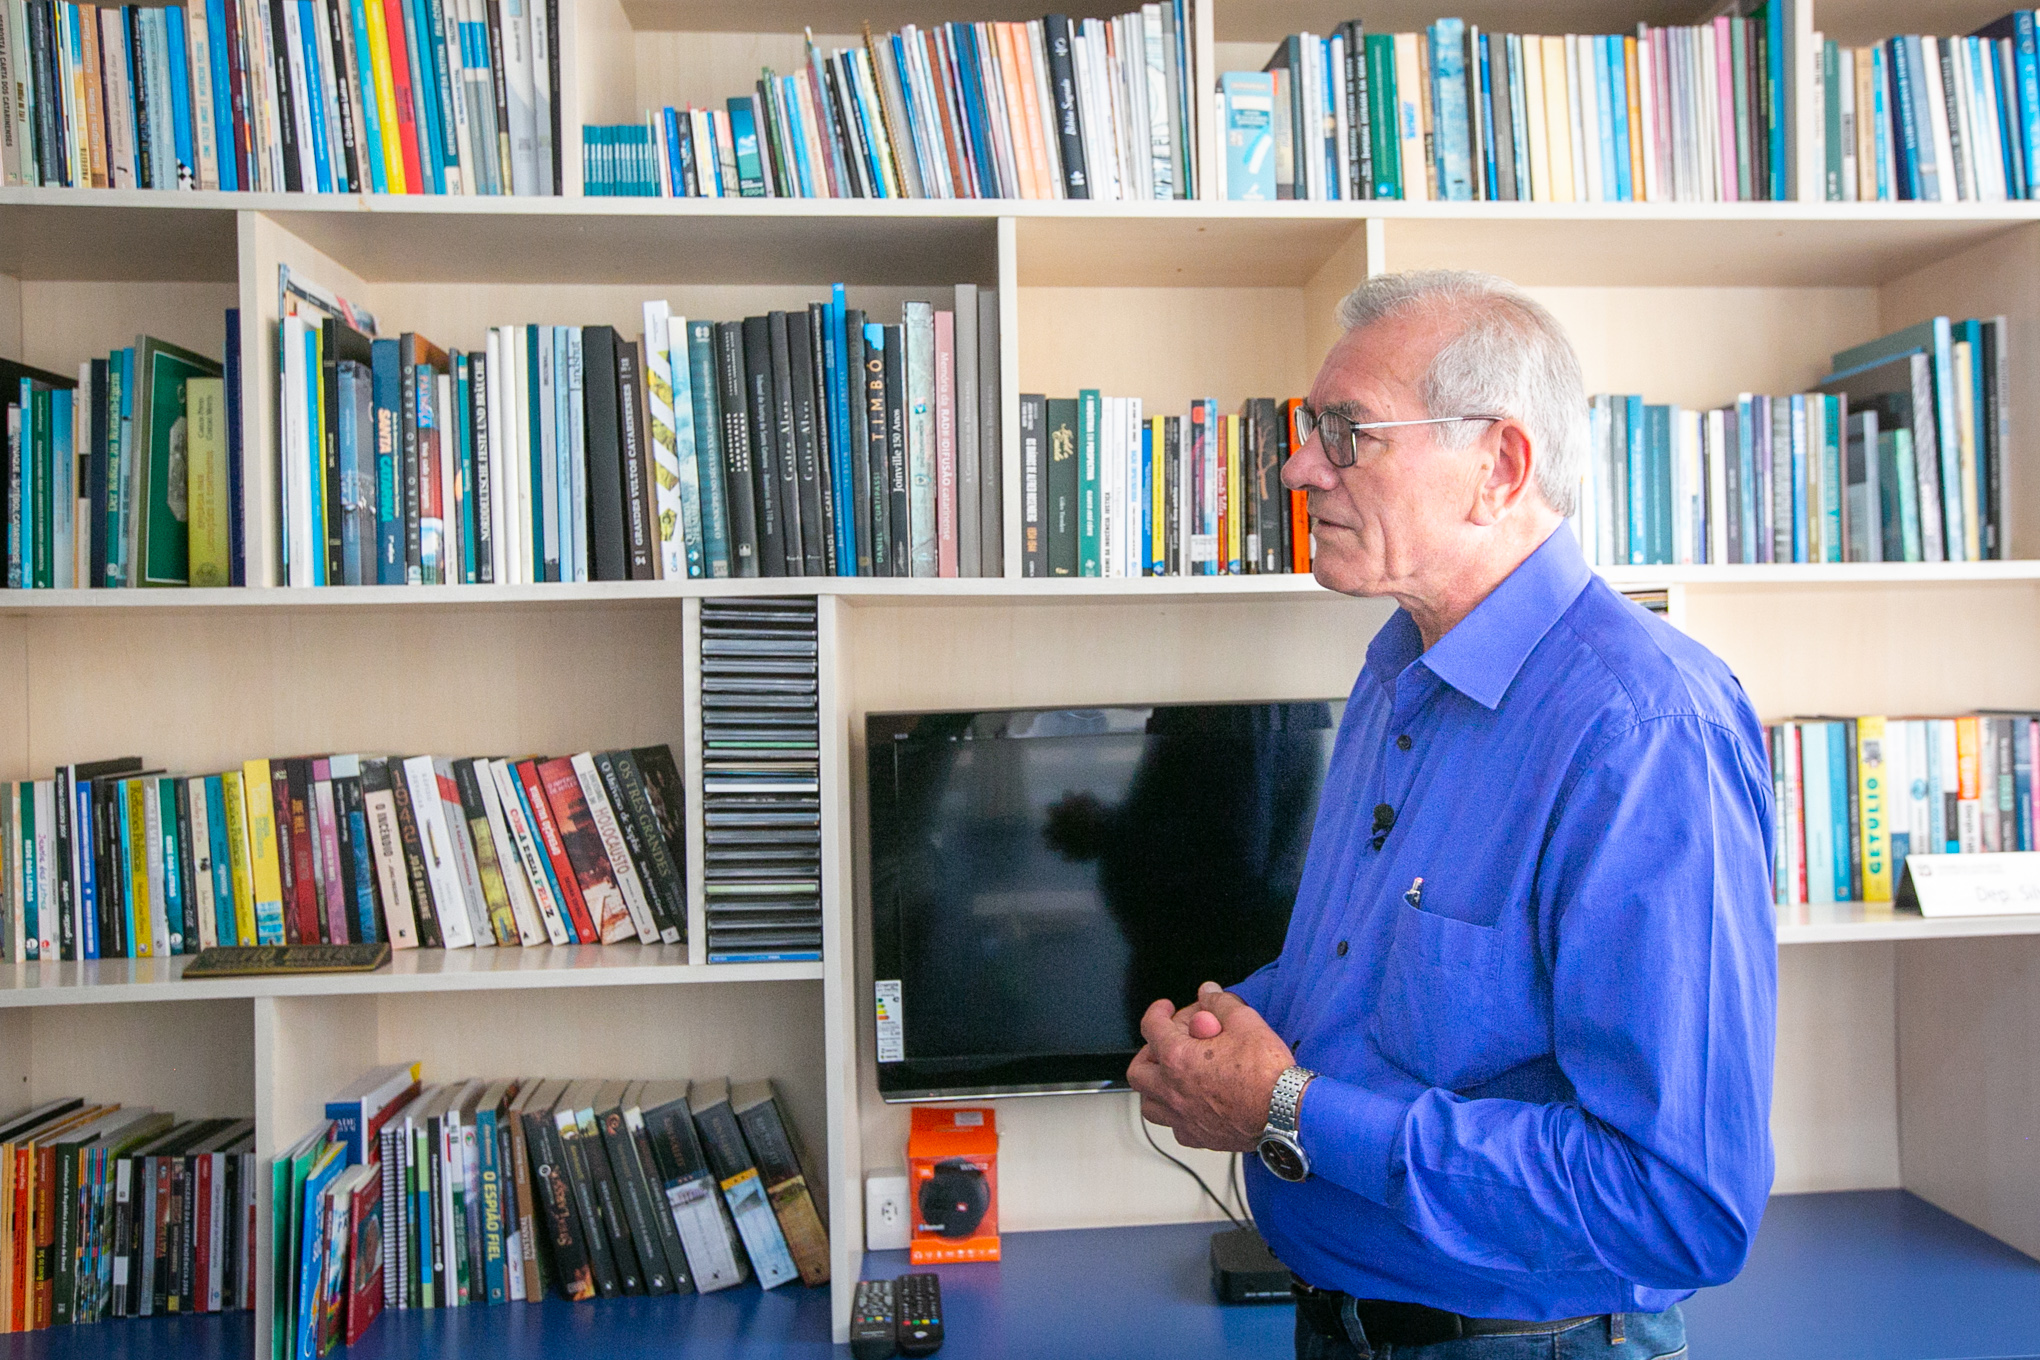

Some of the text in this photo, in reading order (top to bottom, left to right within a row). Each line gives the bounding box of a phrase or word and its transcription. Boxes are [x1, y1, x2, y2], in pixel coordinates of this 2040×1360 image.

[0, 57, 8, 79] CARTA
[3, 97, 13, 147] CATARINENSES
[437, 44, 456, 155] GERENCIAMENTO DA ROTINA
[940, 351, 950, 392] Memória
[866, 359, 884, 441] T.I.M.B.Ó
[941, 394, 950, 406] da
[1086, 400, 1096, 432] INDÚSTRIA
[378, 408, 393, 522] SANTA CATARINA
[404, 365, 417, 550] THEATRO SÃO PEDRO
[475, 359, 490, 542] NORDDEUTSCHE FESTE UND BRÄUCHE
[623, 384, 644, 546] GRANDES VULTOS CATARINENSES
[780, 401, 793, 481] Castro Alves
[800, 401, 813, 481] Castro Alves
[892, 409, 904, 492] Joinville 150 Anos
[1086, 442, 1094, 480] PERSPECTIVA
[708, 452, 718, 488] SÉCULO
[711, 489, 719, 498] NO
[711, 499, 721, 532] MUNICÍPIO
[942, 488, 951, 540] catarinense
[826, 533, 834, 556] ANOS
[876, 533, 884, 563] DANIEL
[1105, 548, 1110, 556] DA
[600, 761, 610, 772] O
[620, 812, 629, 822] de
[618, 760, 632, 780] OS
[131, 786, 144, 831] Reflexões
[292, 799, 304, 814] JOE
[393, 770, 417, 843] 1942
[624, 780, 645, 811] TRÊS
[376, 813, 394, 857] INCÊNDIO
[541, 821, 561, 855] OPERAÇÃO
[596, 806, 630, 875] HOLOCAUSTO
[637, 814, 672, 878] GRANDES
[1868, 777, 1882, 874] GETULIO
[25, 839, 33, 902] REDE DAS LETRAS
[133, 833, 146, 872] Políticas
[165, 835, 176, 897] REDE DAS LETRAS
[510, 808, 527, 842] COMA
[525, 853, 538, 876] SEJA
[534, 878, 555, 918] FELIZ
[414, 880, 431, 920] BARONE
[62, 1185, 69, 1194] da
[182, 1171, 192, 1278] CONCERTO DA INDEPENDÊNCIA
[483, 1171, 501, 1261] O ESPIÃO FIEL
